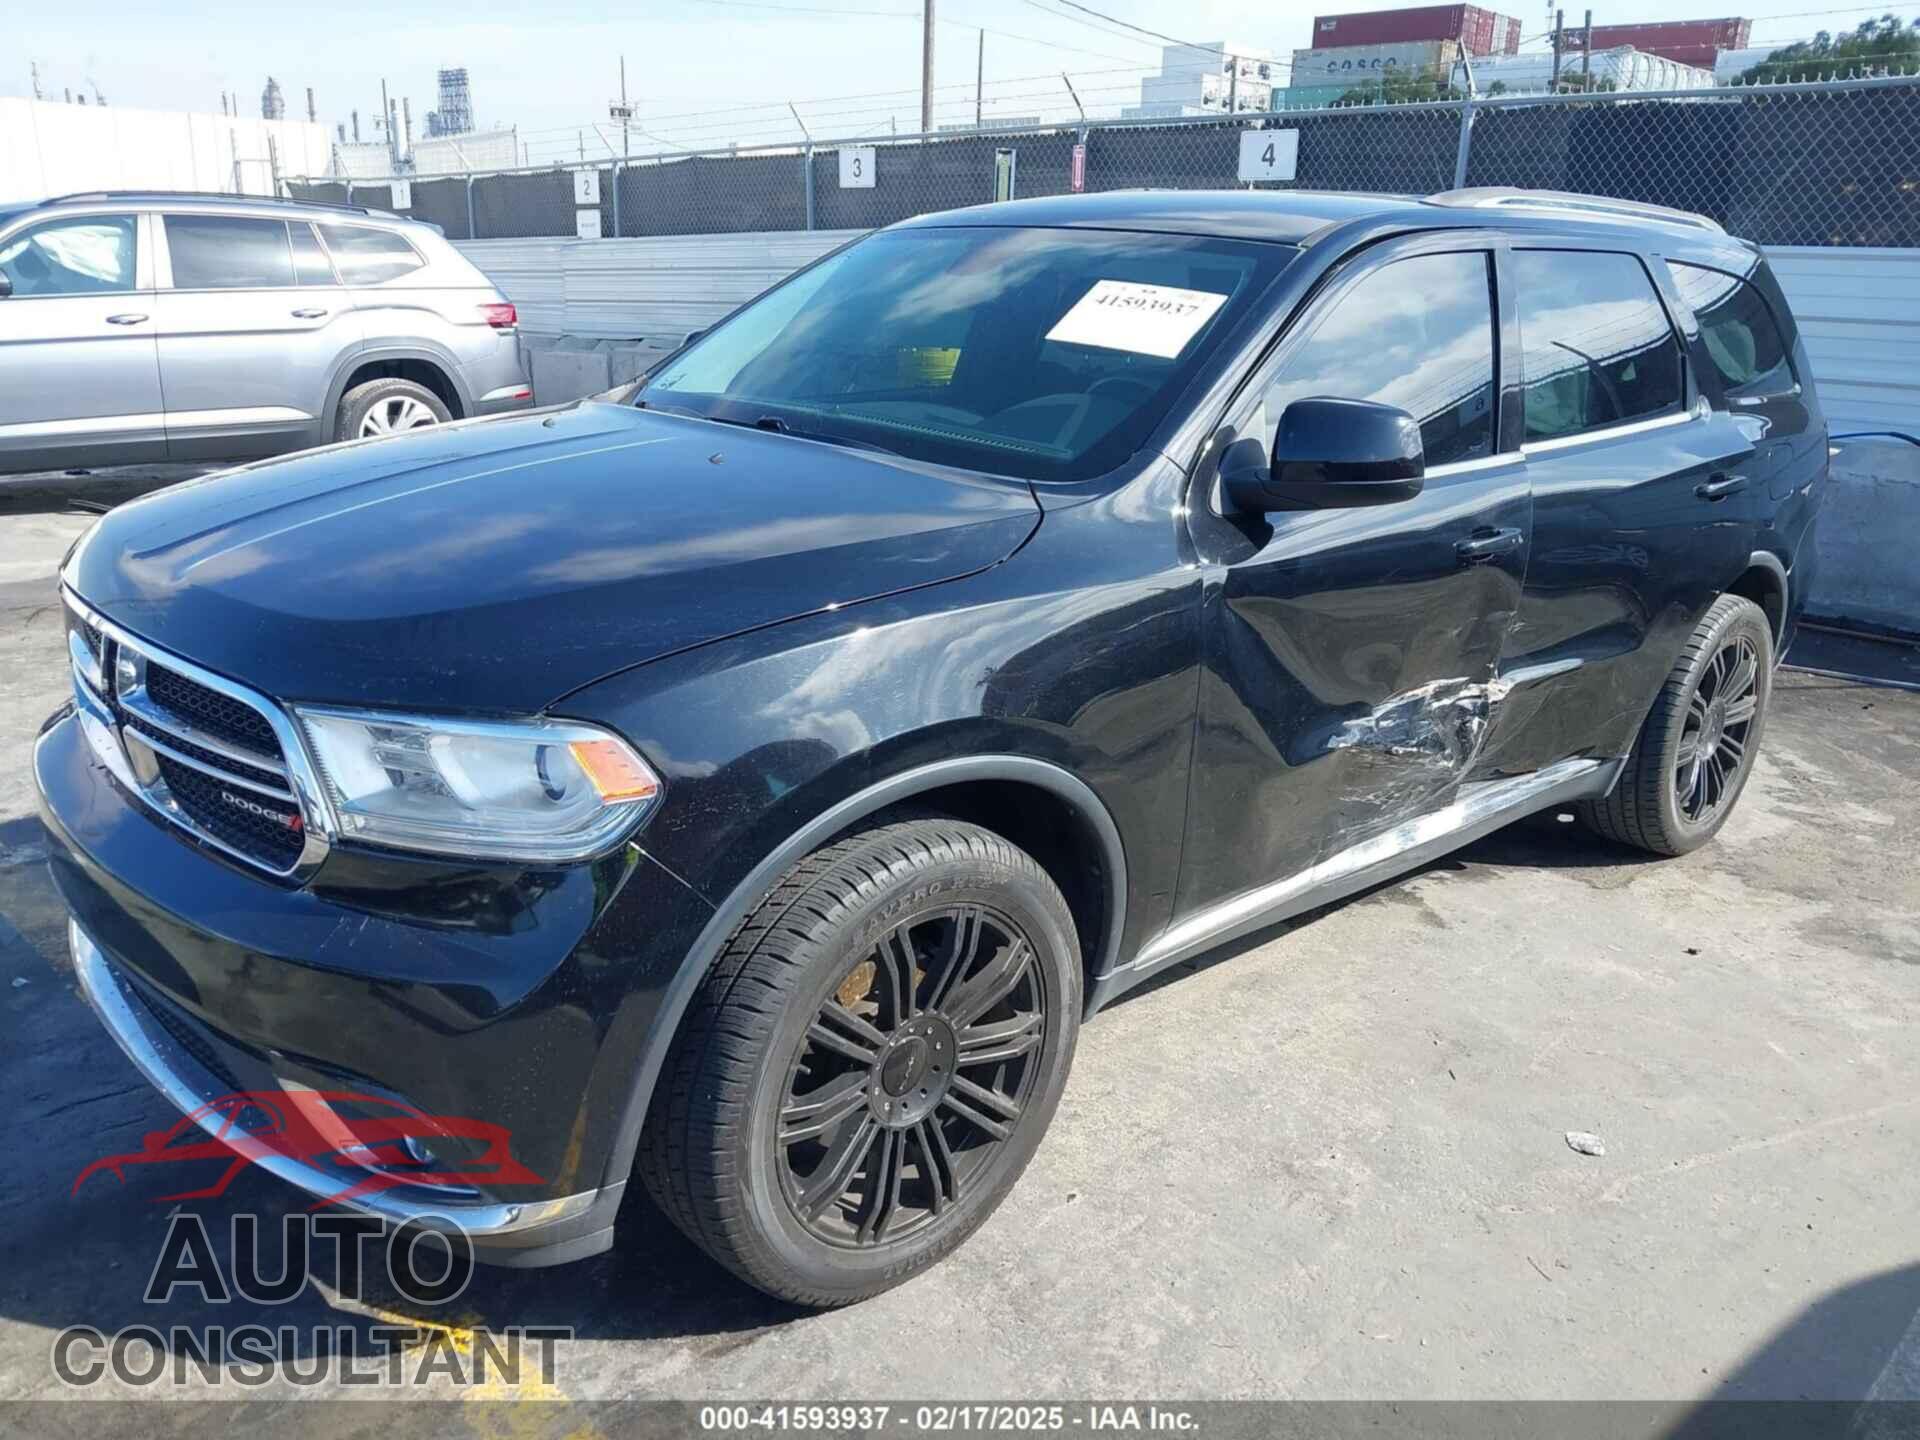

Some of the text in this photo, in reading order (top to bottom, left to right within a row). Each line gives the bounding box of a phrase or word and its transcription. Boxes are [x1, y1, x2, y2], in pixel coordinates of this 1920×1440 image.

[1261, 142, 1276, 167] 4
[853, 157, 862, 178] 3
[583, 179, 591, 196] 2
[1096, 293, 1200, 318] 41593937
[221, 791, 290, 828] DODGE
